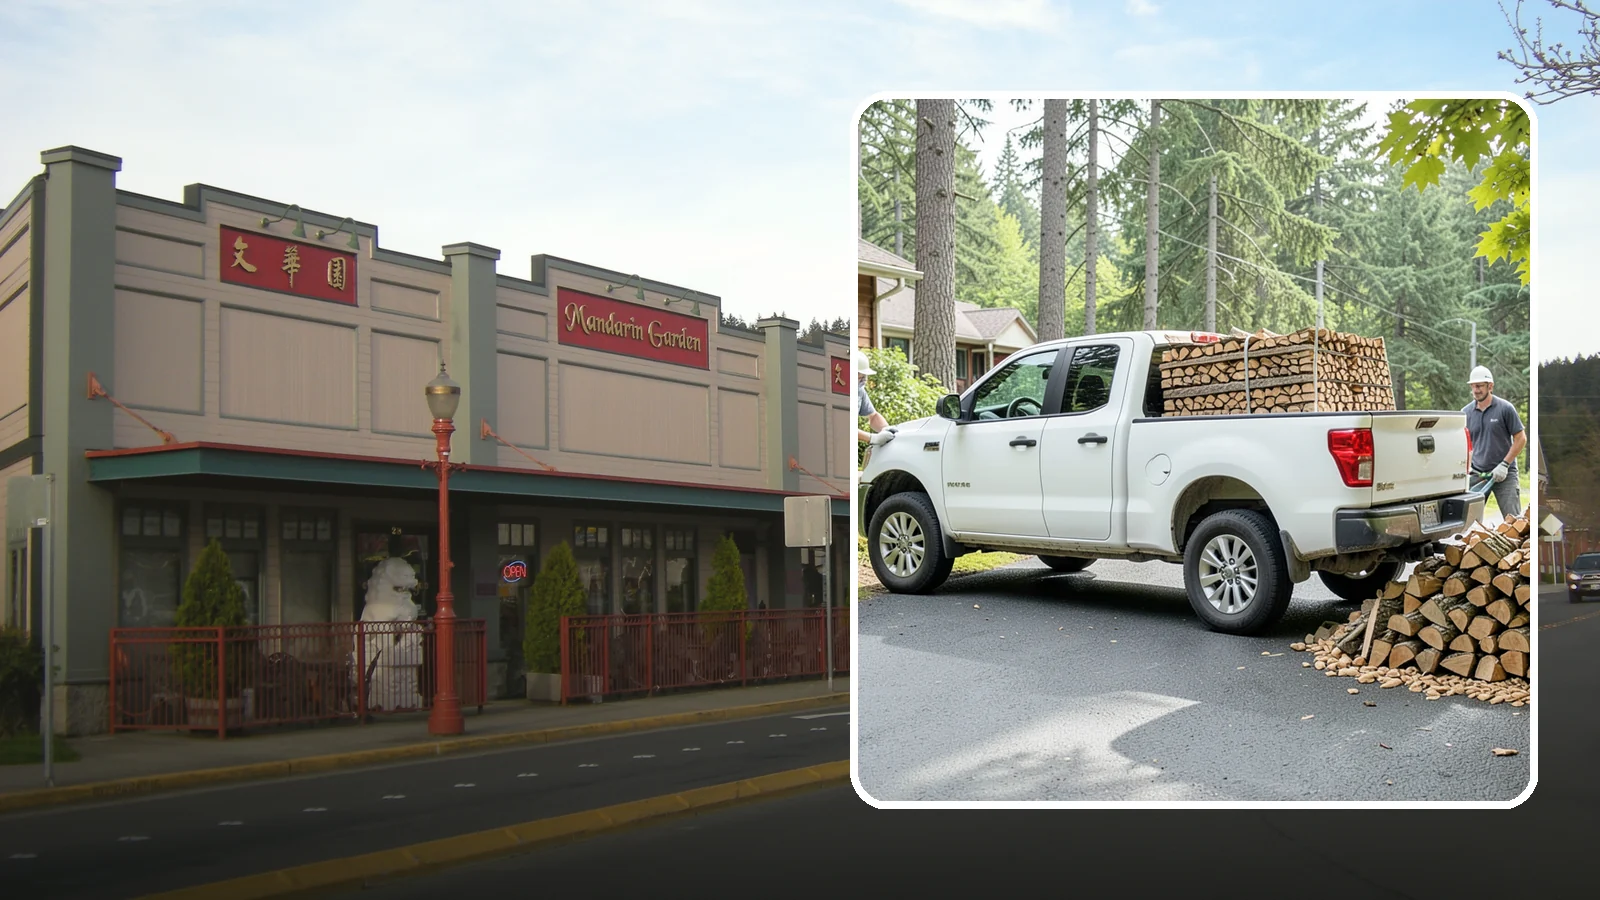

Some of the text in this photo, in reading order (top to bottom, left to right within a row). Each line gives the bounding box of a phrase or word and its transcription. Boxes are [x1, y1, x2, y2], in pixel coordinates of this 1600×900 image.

[564, 302, 701, 352] Mandarin Garden
[503, 565, 527, 578] OPEN
